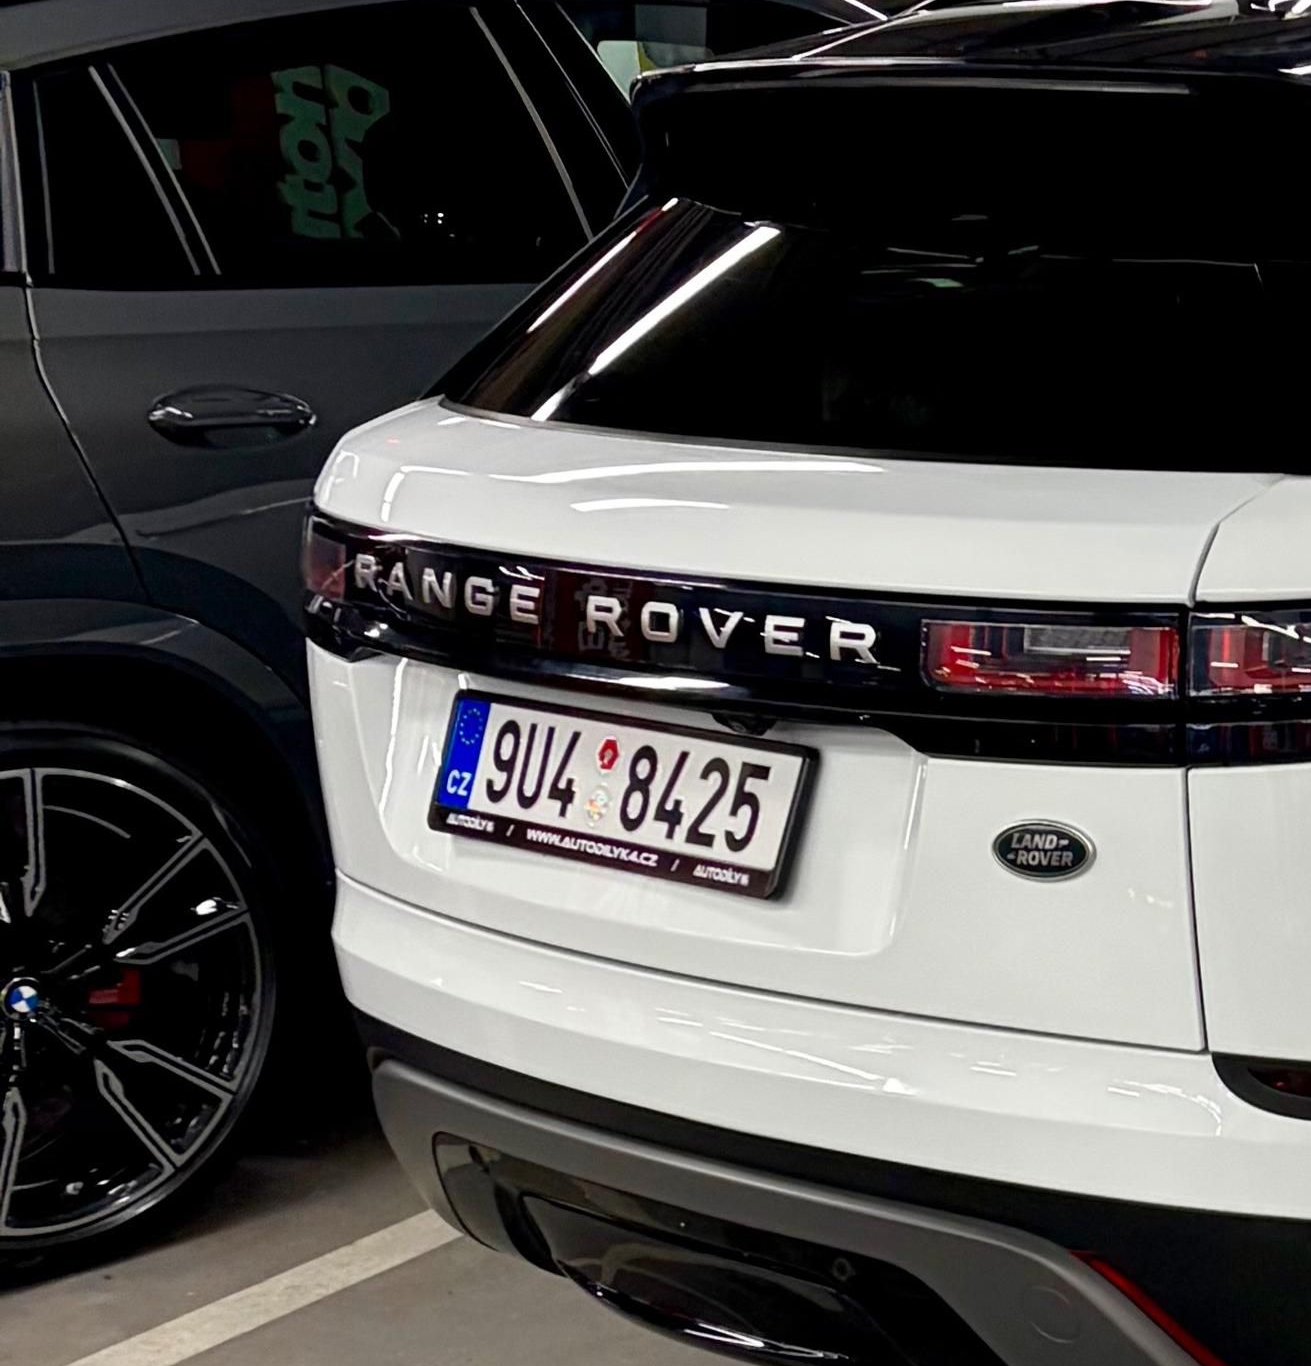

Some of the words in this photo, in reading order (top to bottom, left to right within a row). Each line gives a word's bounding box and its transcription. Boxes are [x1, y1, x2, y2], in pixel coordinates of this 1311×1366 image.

[354, 553, 540, 625] RANGE
[585, 594, 878, 665] ROVER
[446, 768, 473, 797] CZ
[485, 719, 582, 818] 9U4
[619, 744, 772, 853] 8425
[1011, 833, 1058, 850] LAND
[1016, 850, 1074, 866] ROVER
